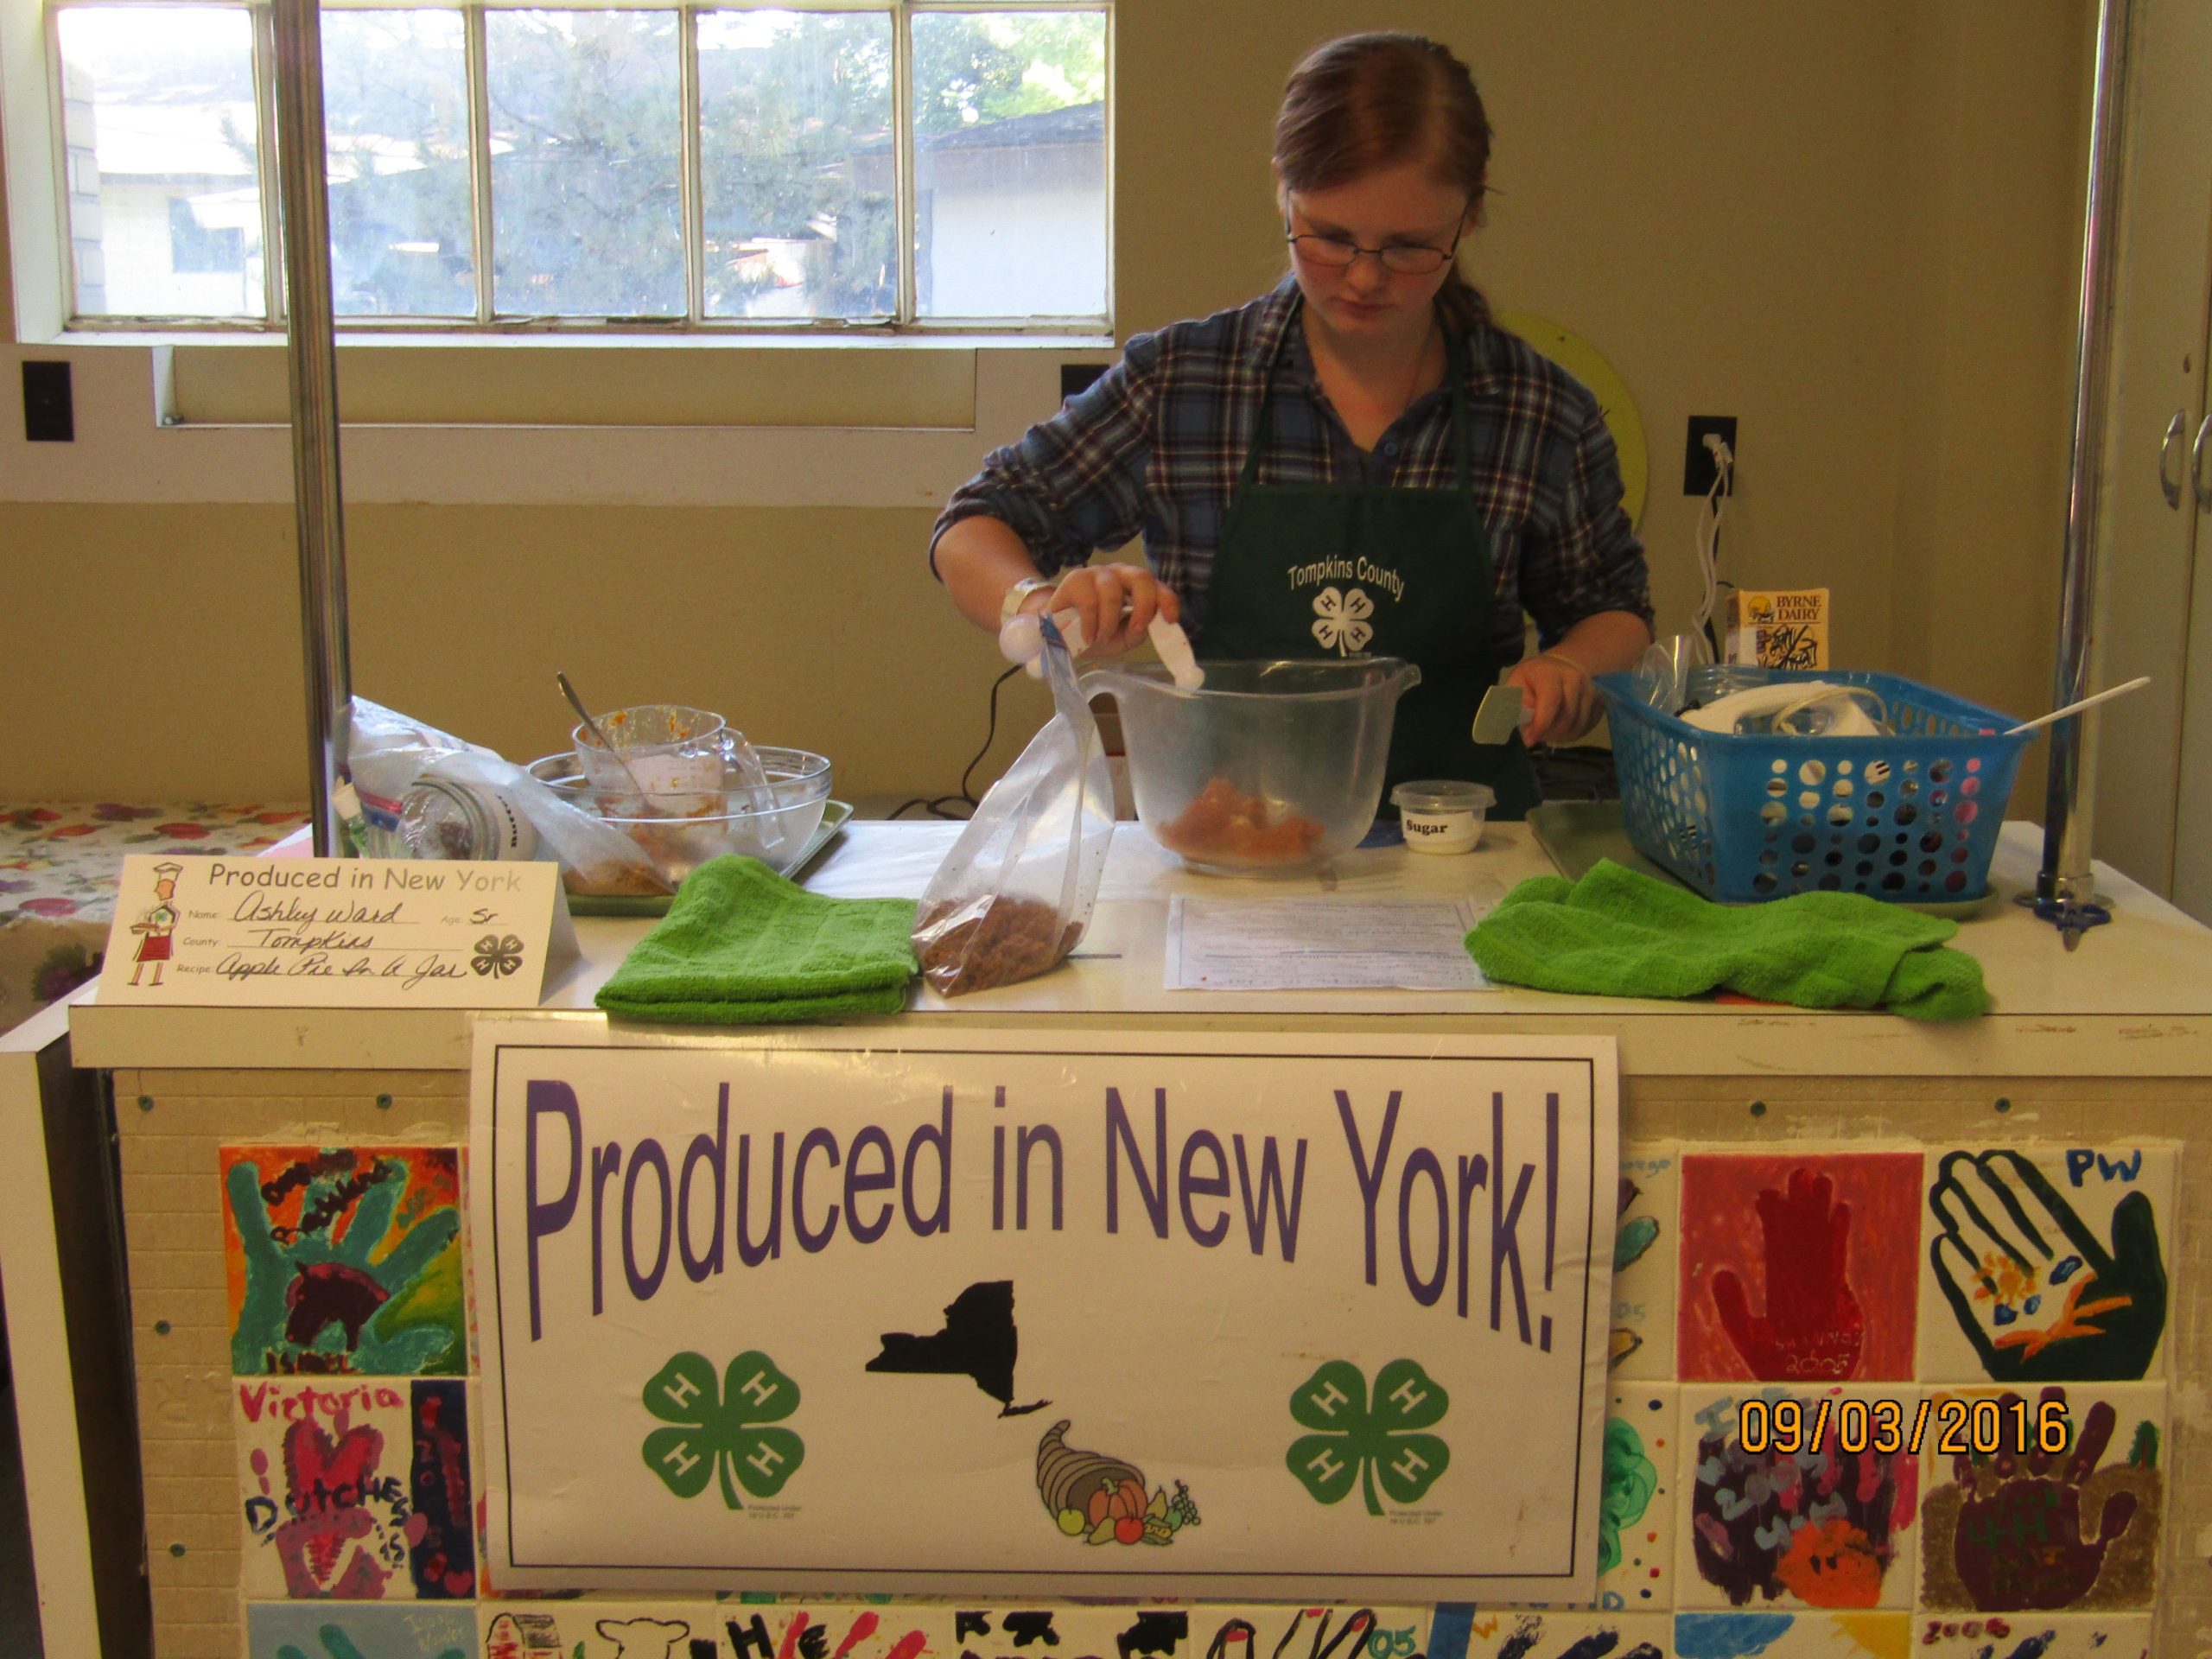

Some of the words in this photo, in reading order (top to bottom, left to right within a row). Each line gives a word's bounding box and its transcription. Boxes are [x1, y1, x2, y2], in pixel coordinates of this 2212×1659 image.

[1287, 555, 1353, 591] Tompkins
[1357, 556, 1404, 601] County
[1776, 595, 1821, 607] BYRNE
[1777, 608, 1820, 620] DAIRY
[1407, 819, 1448, 836] Sugar
[209, 863, 340, 888] Produced
[351, 868, 373, 889] in
[385, 868, 445, 891] New
[457, 870, 521, 892] York
[234, 890, 318, 935] Ashley
[469, 908, 499, 924] Sr
[216, 952, 280, 981] Apple
[288, 952, 332, 976] Pie
[402, 953, 467, 991] Jar
[2067, 1149, 2141, 1185] PW
[526, 1079, 953, 1342] Produced
[992, 1085, 1063, 1230] in
[1106, 1086, 1307, 1262] New
[1333, 1089, 1559, 1352] York!
[240, 1382, 404, 1422] Victoria
